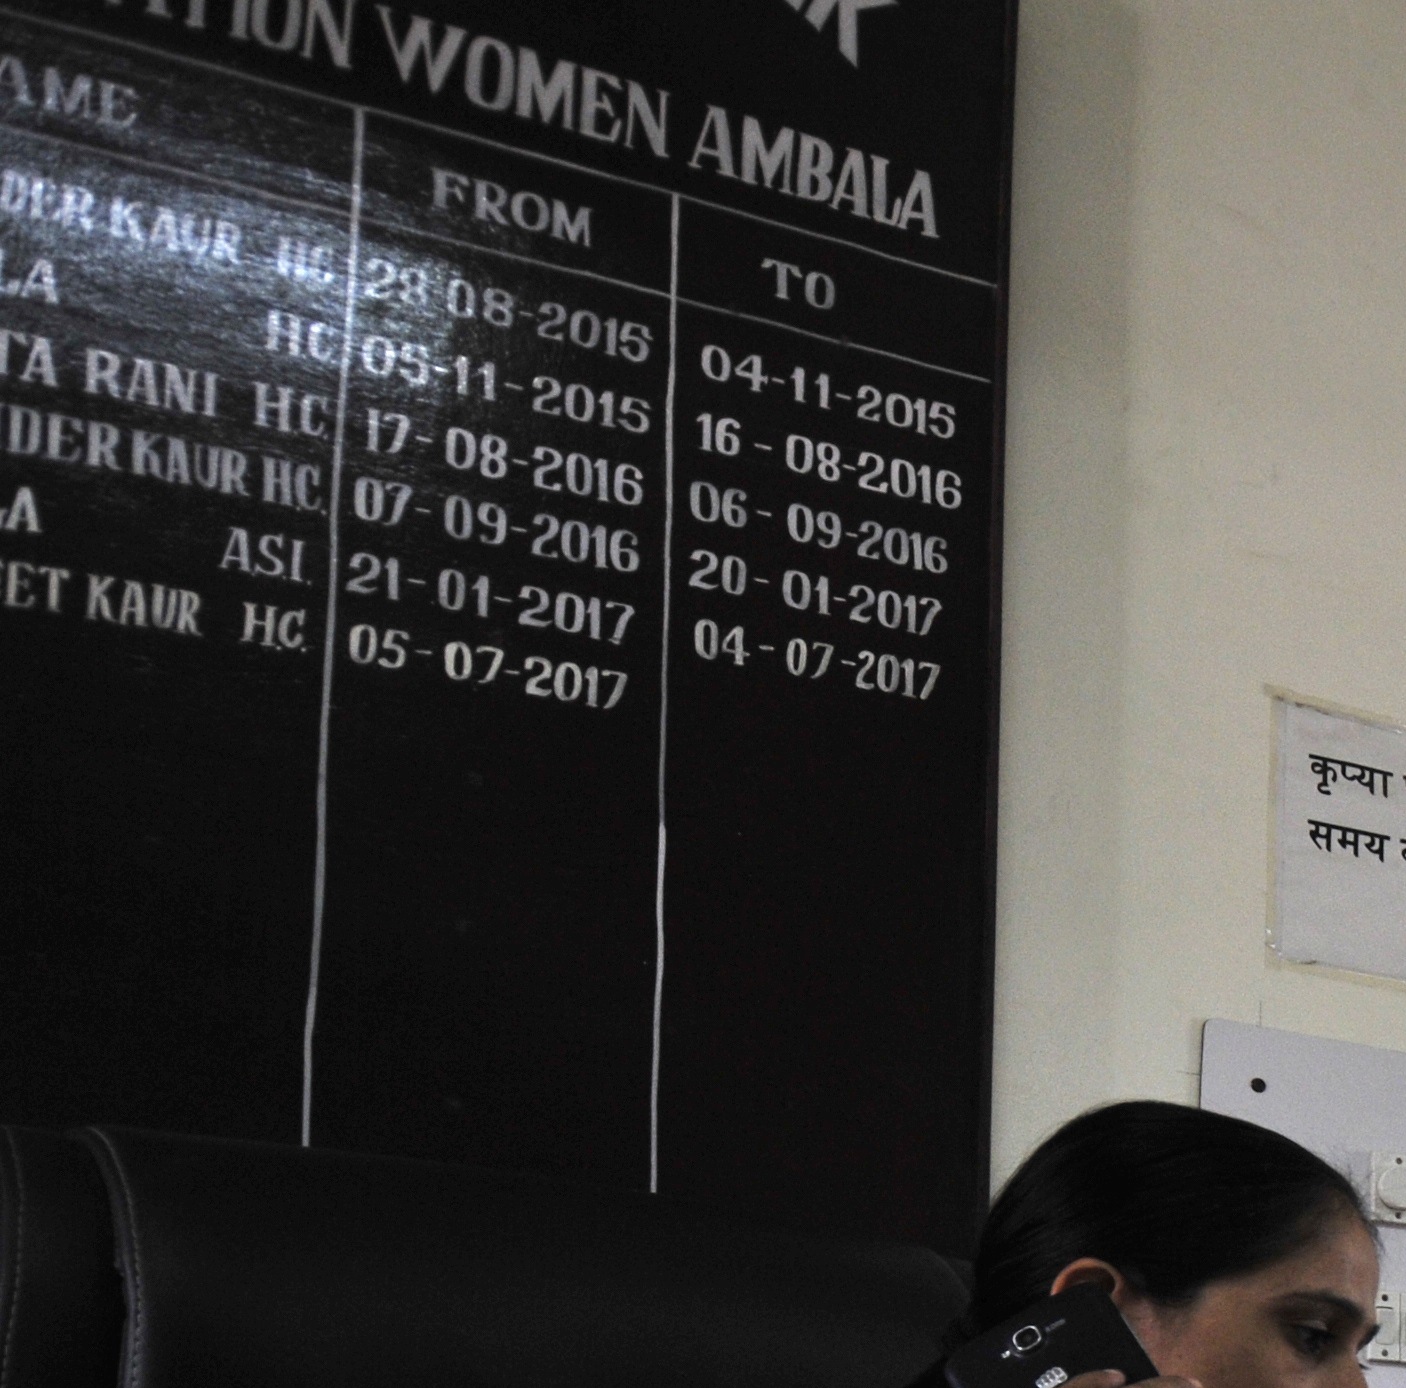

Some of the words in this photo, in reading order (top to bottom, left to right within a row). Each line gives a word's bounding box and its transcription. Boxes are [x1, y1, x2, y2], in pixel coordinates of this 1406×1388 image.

[108, 0, 352, 68] ION
[374, 3, 670, 158] WOMEN
[688, 103, 940, 238] AMBALA
[430, 167, 592, 248] FROM
[761, 258, 836, 310] TO
[110, 197, 242, 265] KAUR
[701, 345, 956, 439] 04-11-2015
[85, 348, 219, 418] RANI
[366, 408, 644, 505] 17-08-2016
[362, 335, 651, 433] 05-11-2015
[87, 573, 205, 637] KAUR
[1309, 753, 1394, 798] कृप्या
[1308, 818, 1391, 862] समय
